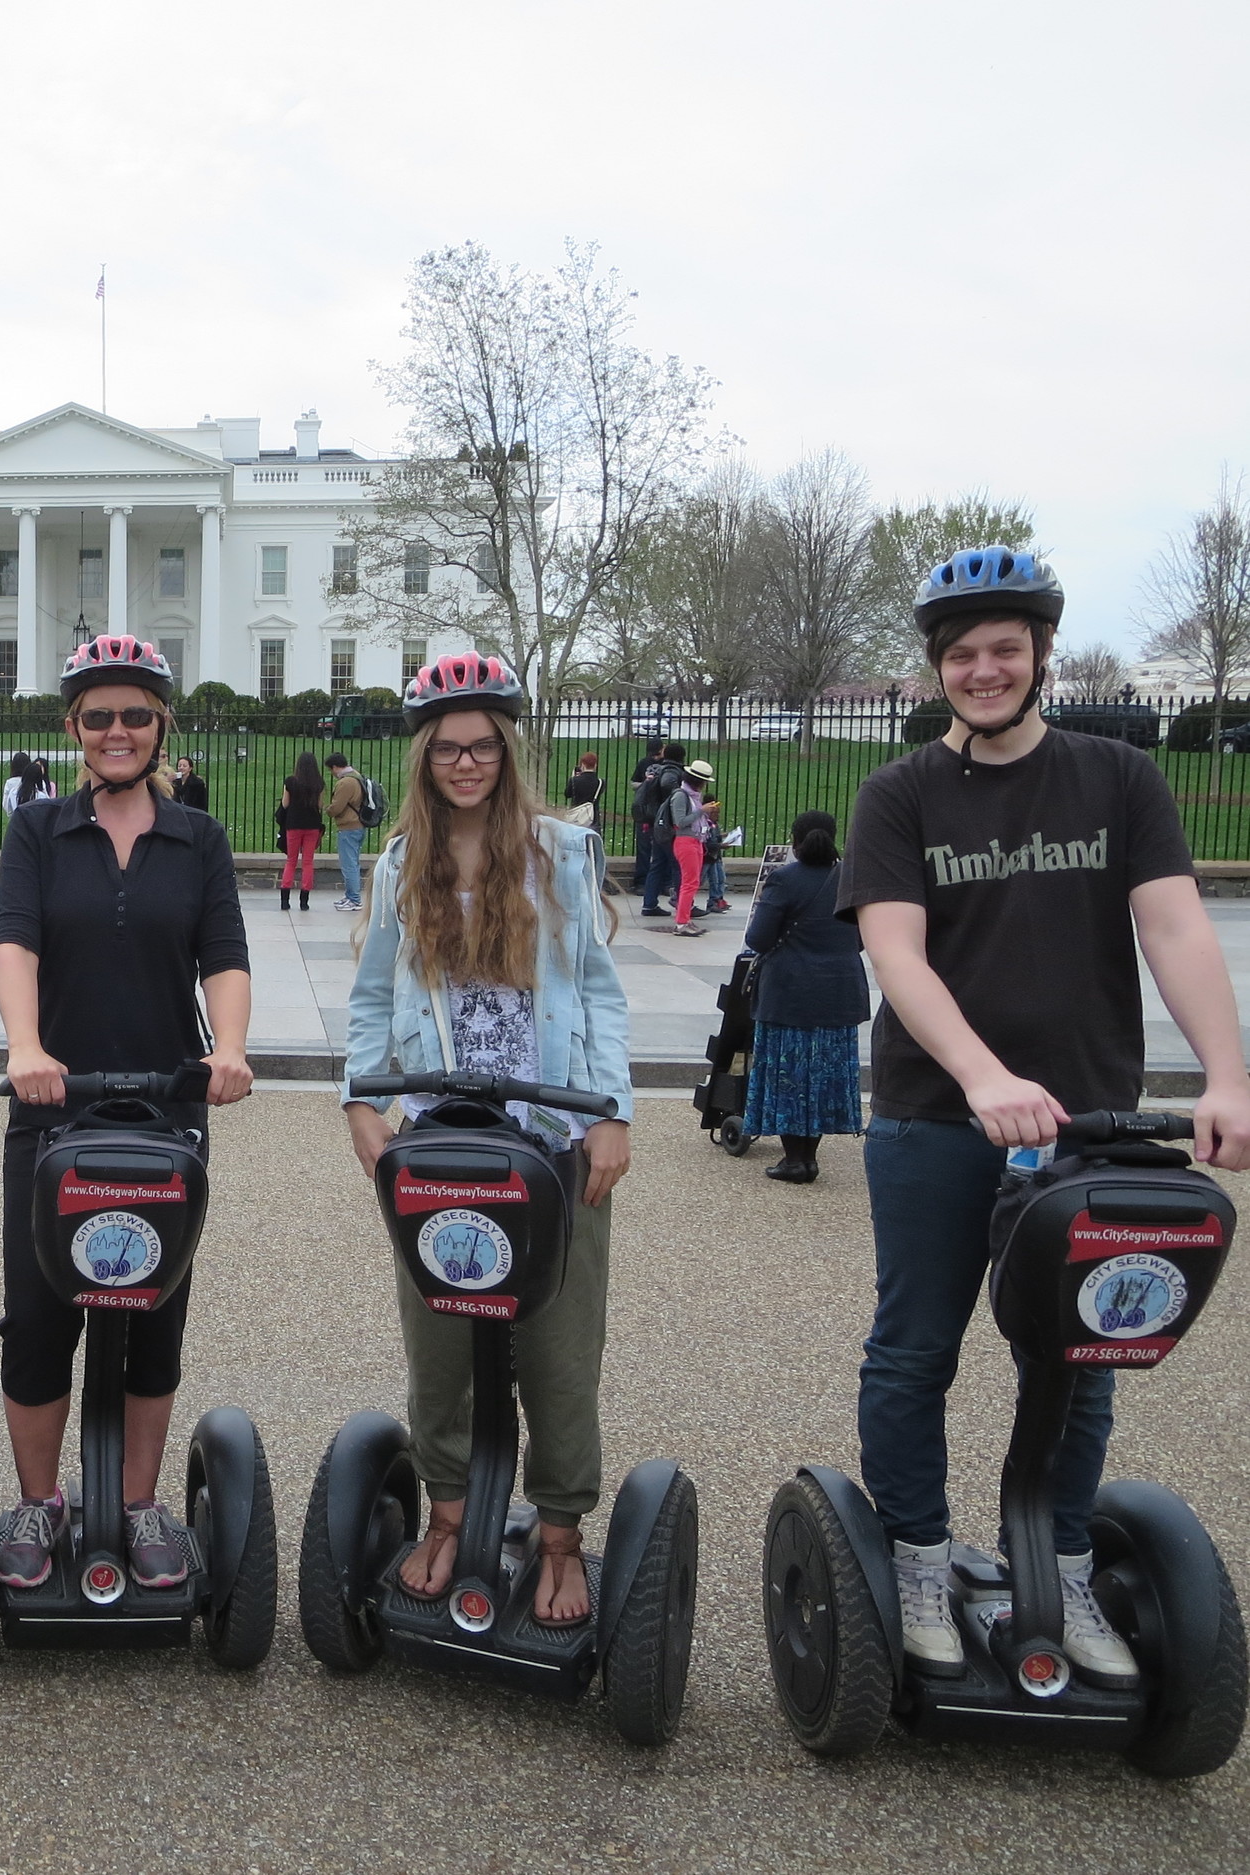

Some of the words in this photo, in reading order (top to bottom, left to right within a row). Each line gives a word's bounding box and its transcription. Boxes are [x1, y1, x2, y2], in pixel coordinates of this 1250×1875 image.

[925, 827, 1108, 887] Timberland
[64, 1185, 181, 1200] www.CitySegwayTours.com
[400, 1184, 522, 1199] www.CitySegwayTours.com
[76, 1221, 96, 1243] CITY
[98, 1214, 152, 1235] SEGWAY
[144, 1235, 159, 1272] TOURS
[421, 1217, 440, 1241] CITY
[441, 1211, 499, 1234] SEGWAY
[496, 1236, 509, 1275] TOURS
[1074, 1229, 1215, 1244] www.CitySegwayTours.com
[1085, 1263, 1112, 1289] CITY
[1116, 1255, 1178, 1281] SEGWAY
[1160, 1279, 1187, 1326] TOURS
[433, 1299, 510, 1316] 877-SEG-TOUR
[1072, 1348, 1159, 1360] 877-SEG-TOUR
